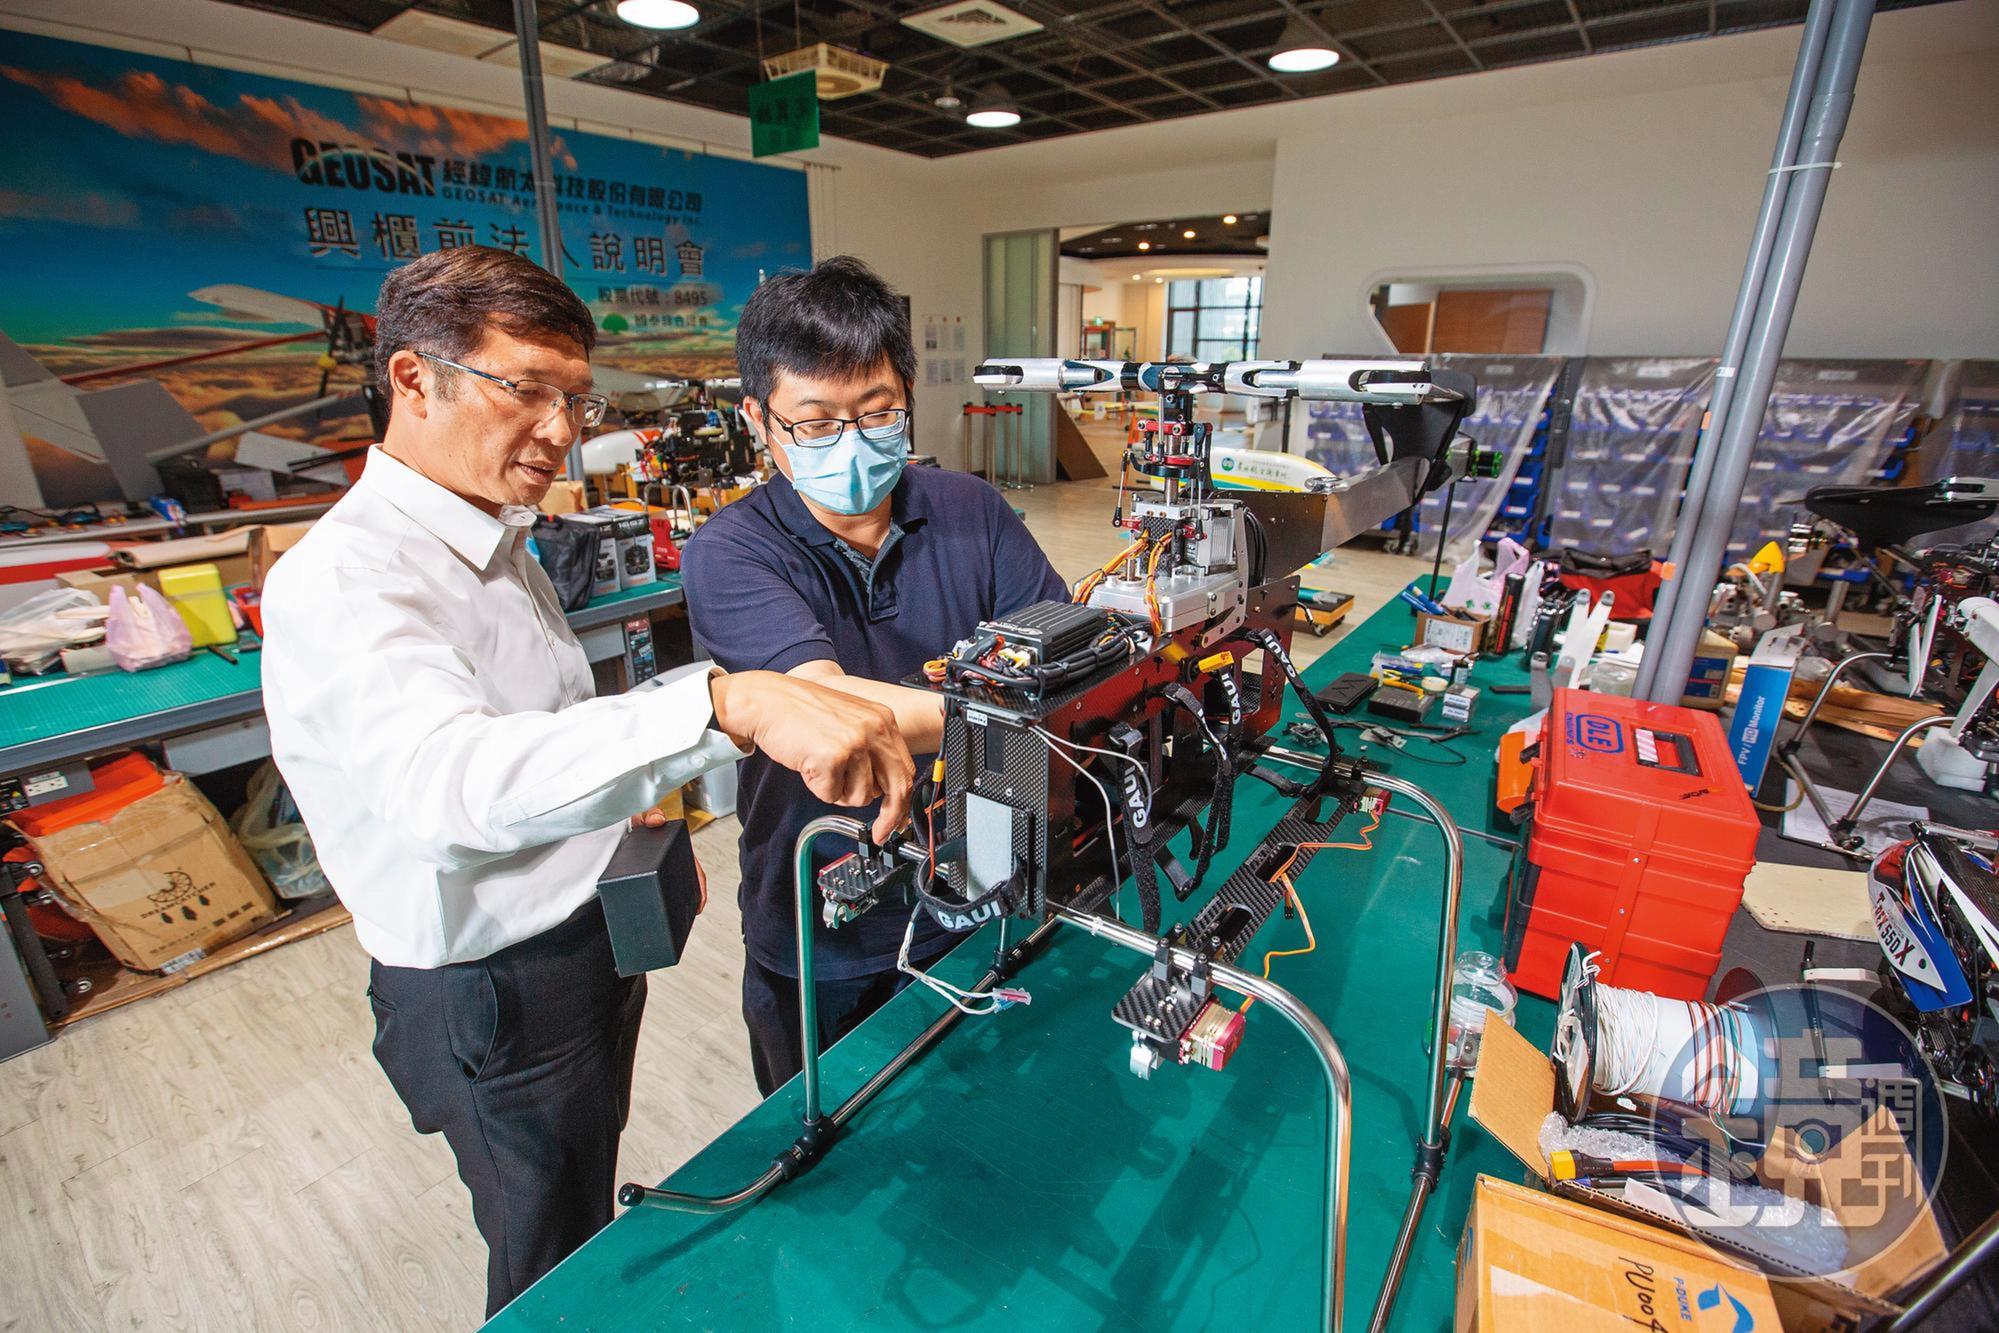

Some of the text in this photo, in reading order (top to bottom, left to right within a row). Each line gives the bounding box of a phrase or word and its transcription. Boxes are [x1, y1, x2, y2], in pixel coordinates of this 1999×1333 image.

[290, 138, 436, 196] GEOSAT
[442, 187, 506, 207] GEOSAT
[1264, 634, 1297, 678] GAUI
[1221, 673, 1241, 725] GAUI
[1586, 720, 1612, 748] DLE
[1737, 746, 1751, 766] FPV
[1748, 696, 1766, 728] Monitor
[1124, 765, 1147, 828] GAUI
[140, 882, 216, 919] DREAMCATCHER
[937, 900, 1002, 929] GAUI
[1673, 1276, 1692, 1321] P-DUKE
